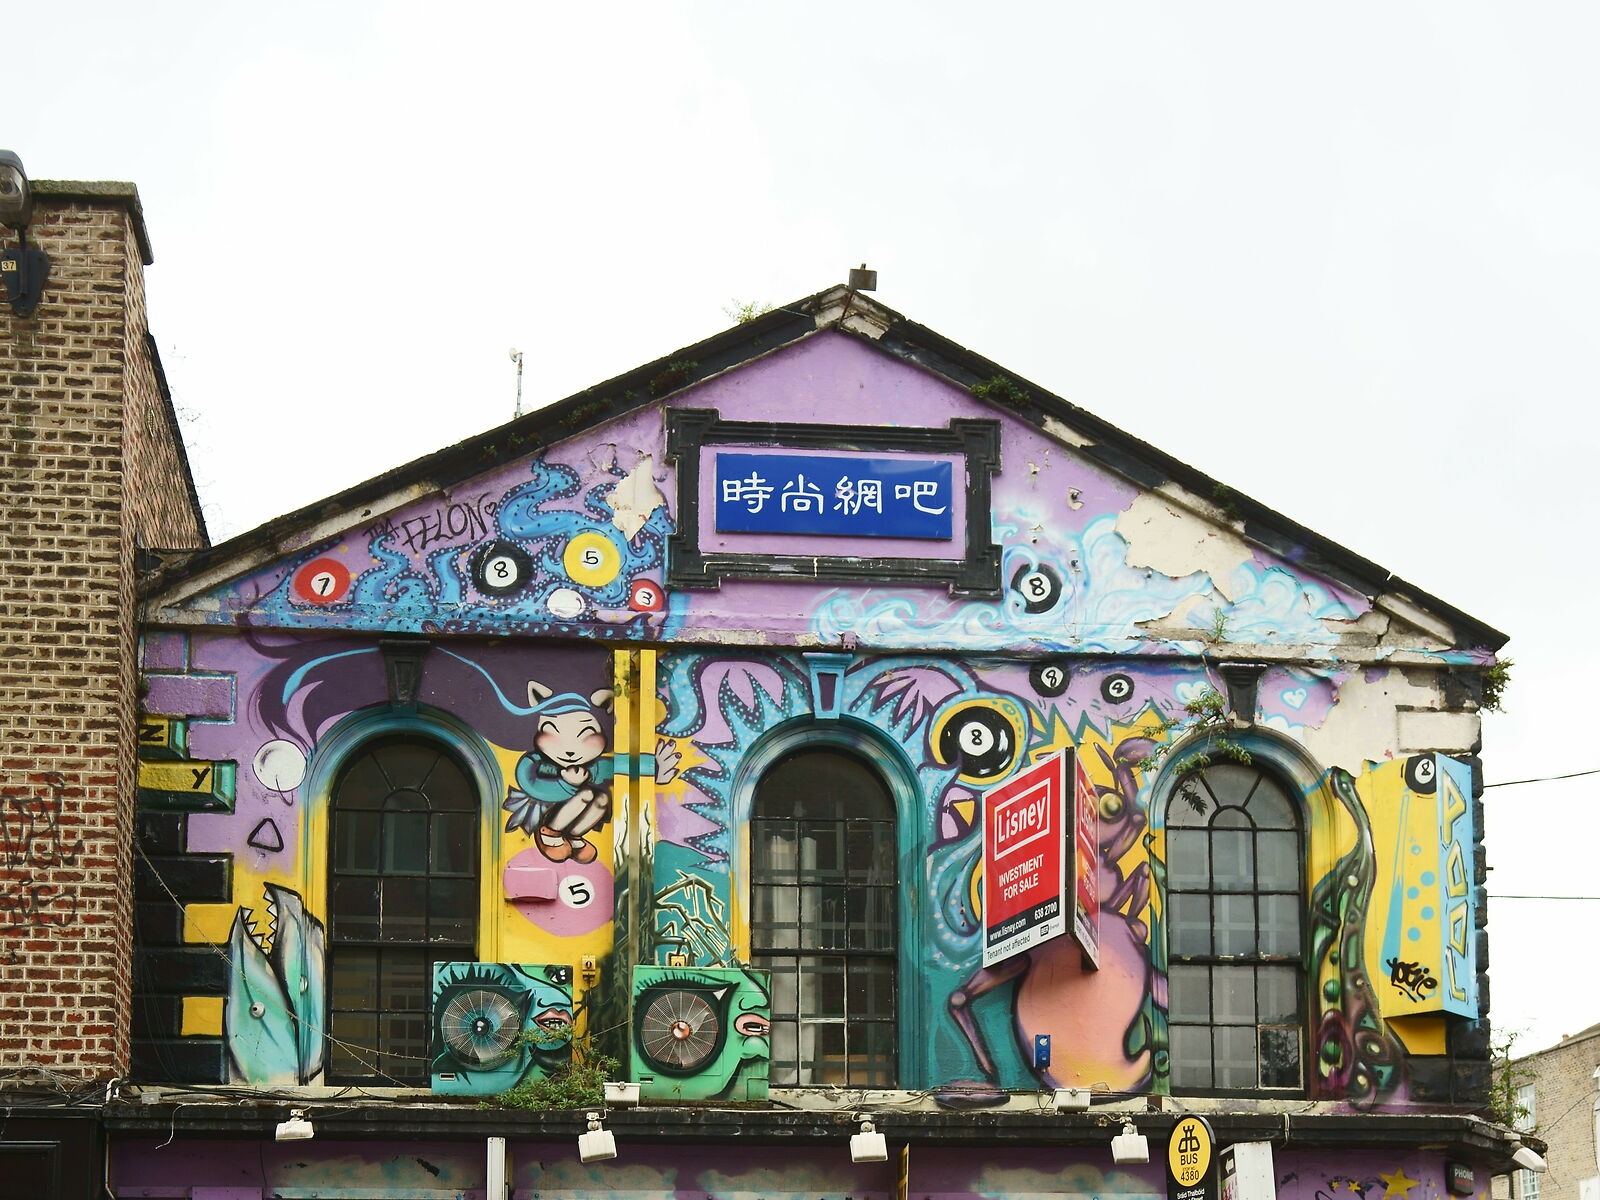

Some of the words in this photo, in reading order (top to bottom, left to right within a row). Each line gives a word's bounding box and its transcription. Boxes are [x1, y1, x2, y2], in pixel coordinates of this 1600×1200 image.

[722, 471, 946, 515] 時尚網吧
[581, 550, 599, 566] 5
[493, 561, 508, 579] 8
[1029, 576, 1046, 597] 8
[641, 590, 653, 606] 3
[971, 728, 983, 746] 8
[1420, 760, 1431, 776] 8
[191, 767, 210, 790] Y
[998, 796, 1046, 843] Lisney
[999, 854, 1044, 887] INVESTMENT
[567, 882, 591, 905] 5
[1004, 882, 1019, 901] FOR
[1020, 872, 1039, 893] SALE
[989, 918, 1027, 942] www.lisney.com
[1044, 902, 1058, 917] 2700
[987, 947, 1003, 960] Tenant
[1180, 1153, 1198, 1166] BUS
[1180, 1170, 1200, 1181] 4380
[1455, 1168, 1474, 1181] PHONE
